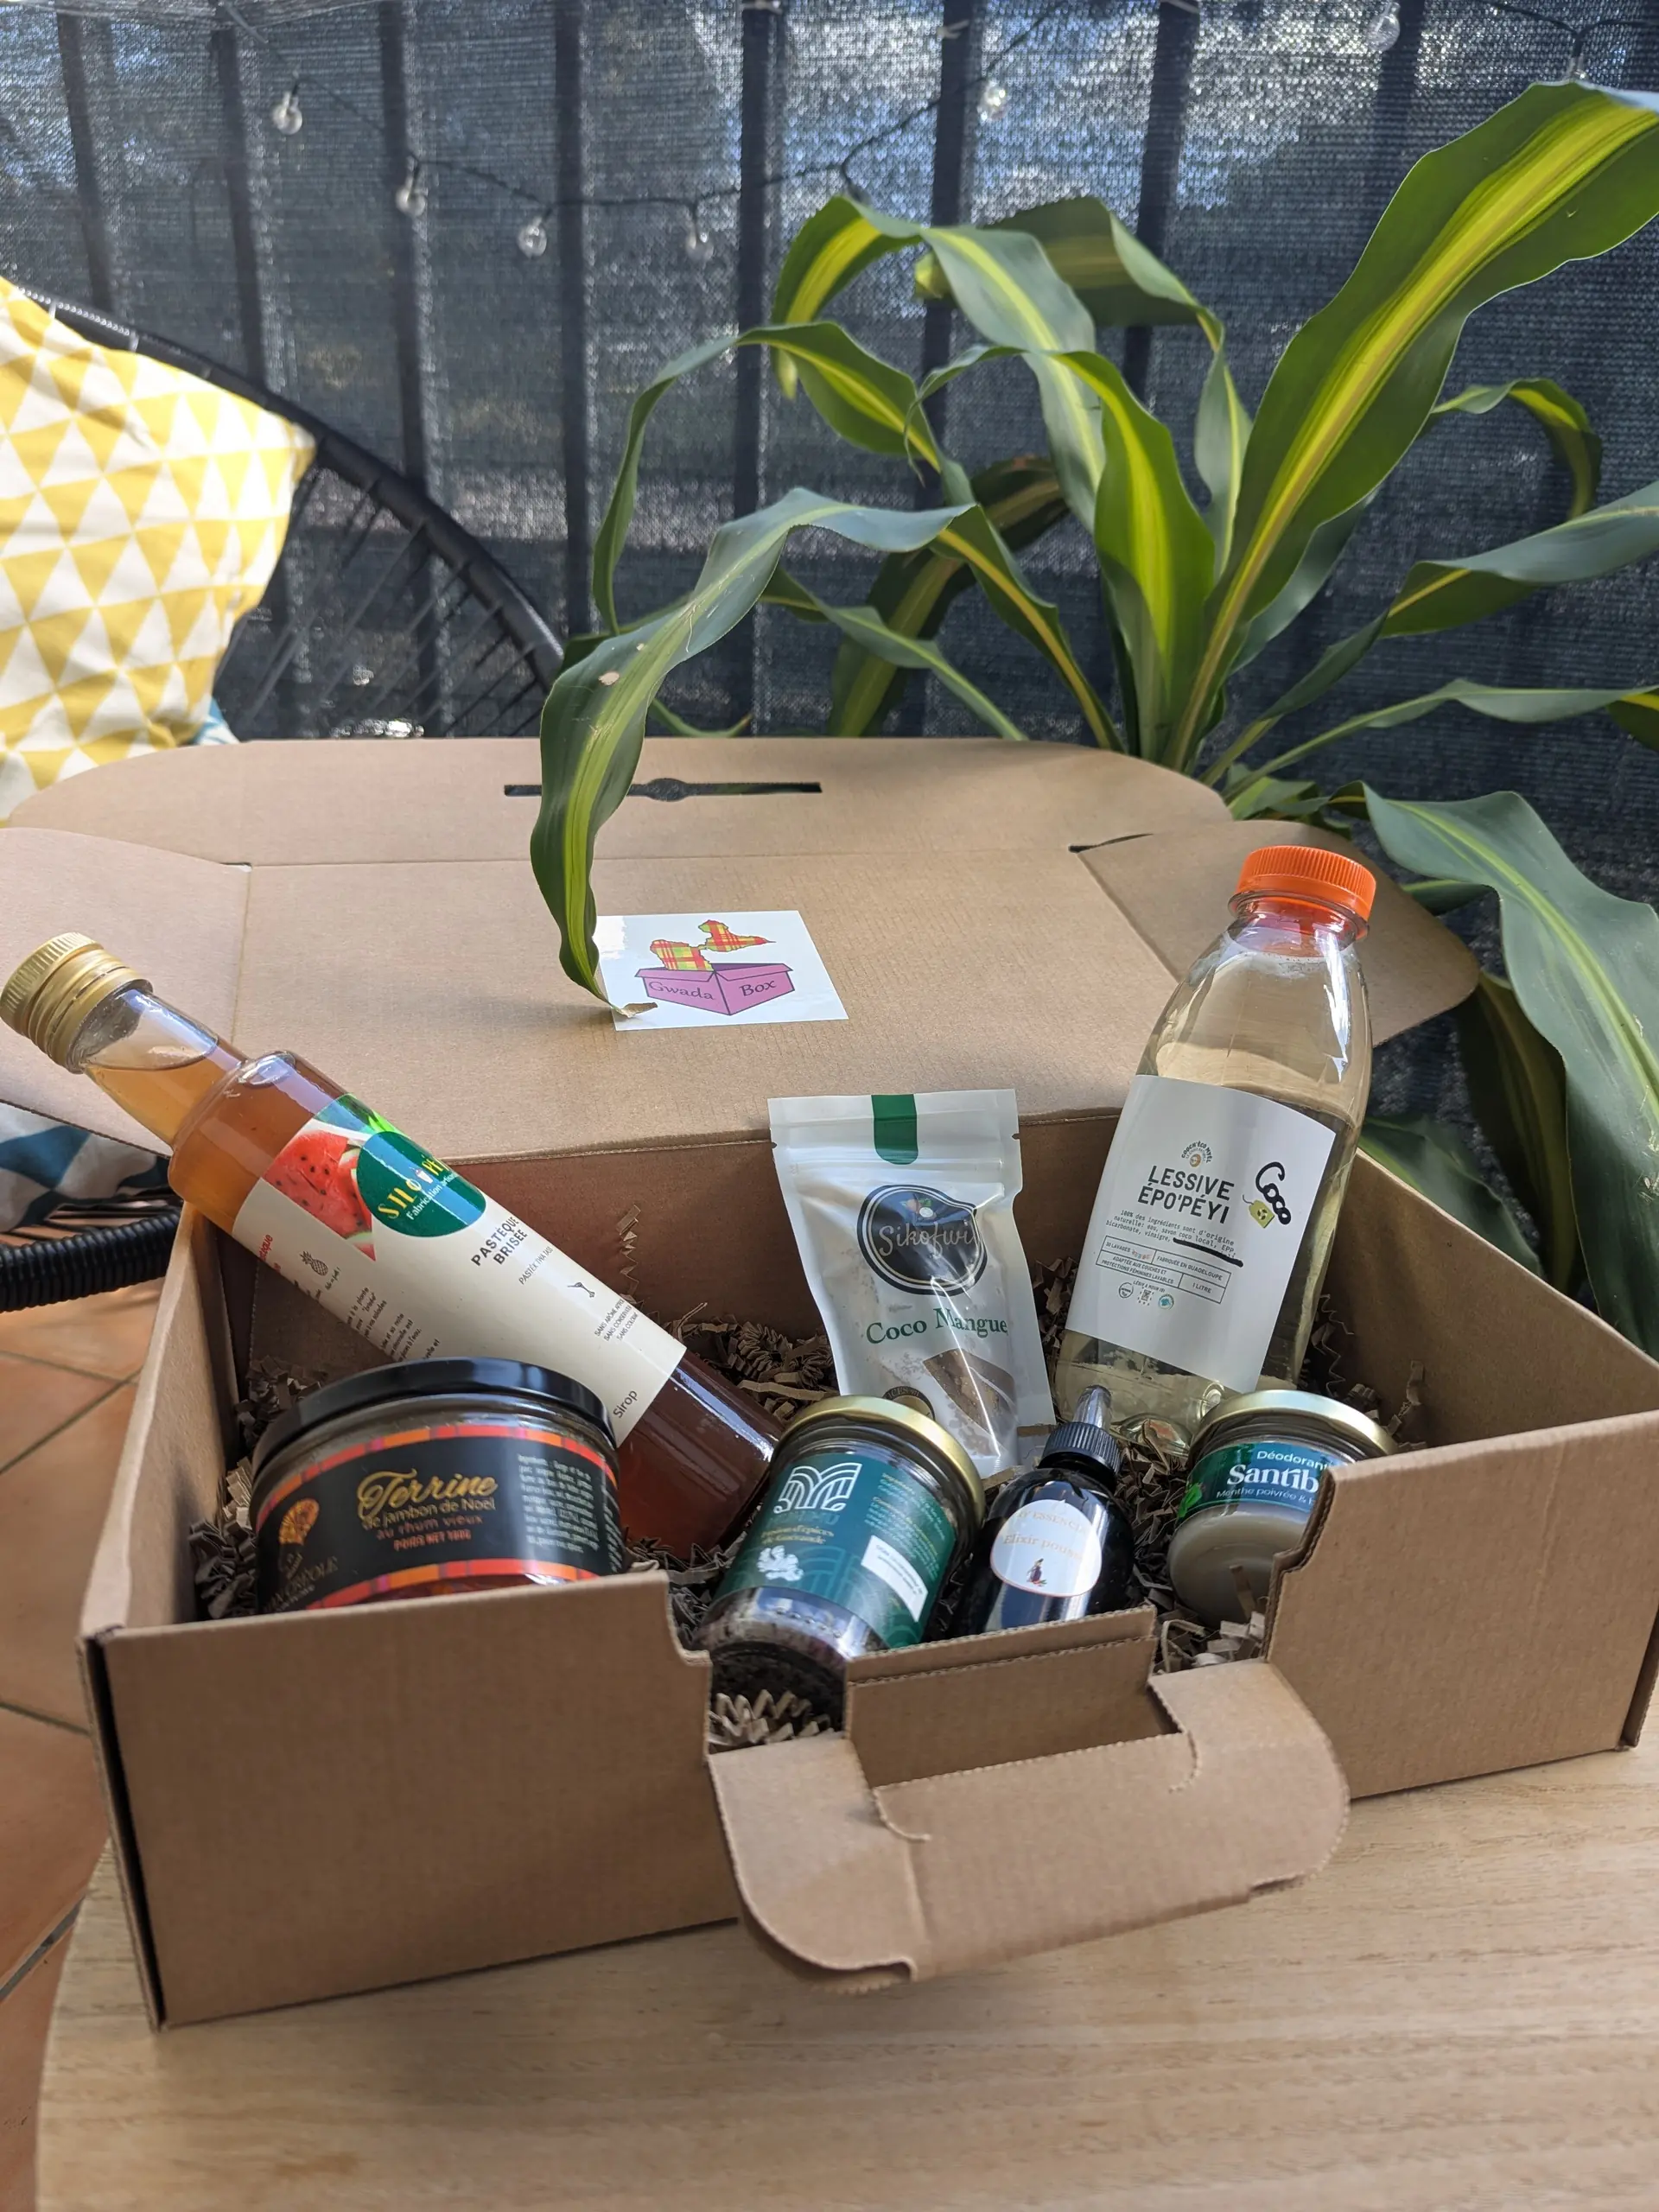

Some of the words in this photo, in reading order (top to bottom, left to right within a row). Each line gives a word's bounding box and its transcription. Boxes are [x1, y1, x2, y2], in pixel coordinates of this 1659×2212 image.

[649, 981, 715, 1001] Gwada
[739, 980, 777, 996] Box
[1148, 1165, 1235, 1201] LESSIVE
[406, 1183, 442, 1220] Fabrication
[1137, 1182, 1230, 1224] ÉPO'PÉYI
[1106, 1219, 1141, 1235] bicarbonate,
[1144, 1230, 1171, 1243] vinaigre,
[1114, 1215, 1144, 1228] naturelle:
[1161, 1227, 1177, 1236] savon
[1195, 1236, 1217, 1249] local,
[1121, 1210, 1133, 1218] 100%
[1135, 1211, 1145, 1221] des
[1147, 1217, 1180, 1230] ingrédients
[1182, 1225, 1196, 1234] sont
[1198, 1230, 1234, 1246] d'origine
[493, 1229, 528, 1265] BRISÉE
[1111, 1243, 1130, 1253] LAVAGES
[1102, 1259, 1129, 1272] PROTECTIONS
[1129, 1267, 1152, 1279] FÉMININES
[1152, 1273, 1174, 1284] LAVABLES
[1112, 1255, 1133, 1265] ADAPTÉE
[1141, 1263, 1160, 1274] COUCHES
[1156, 1255, 1180, 1267] FABRIQUÉE
[1196, 1283, 1212, 1294] LITRE
[594, 1322, 607, 1336] SANS
[604, 1327, 616, 1341] SANS
[617, 1327, 628, 1340] SANS
[866, 1320, 927, 1344] Coco
[933, 1307, 1008, 1338] Mangue
[613, 1390, 638, 1419] Sirop
[1227, 1464, 1319, 1493] Santib
[357, 1468, 499, 1520] Terrine
[1217, 1486, 1255, 1498] Menthe
[1256, 1487, 1297, 1500] poivrée
[381, 1503, 439, 1529] jambon
[439, 1499, 460, 1513] de
[397, 1518, 440, 1535] rhum
[1003, 1531, 1039, 1545] Elixir
